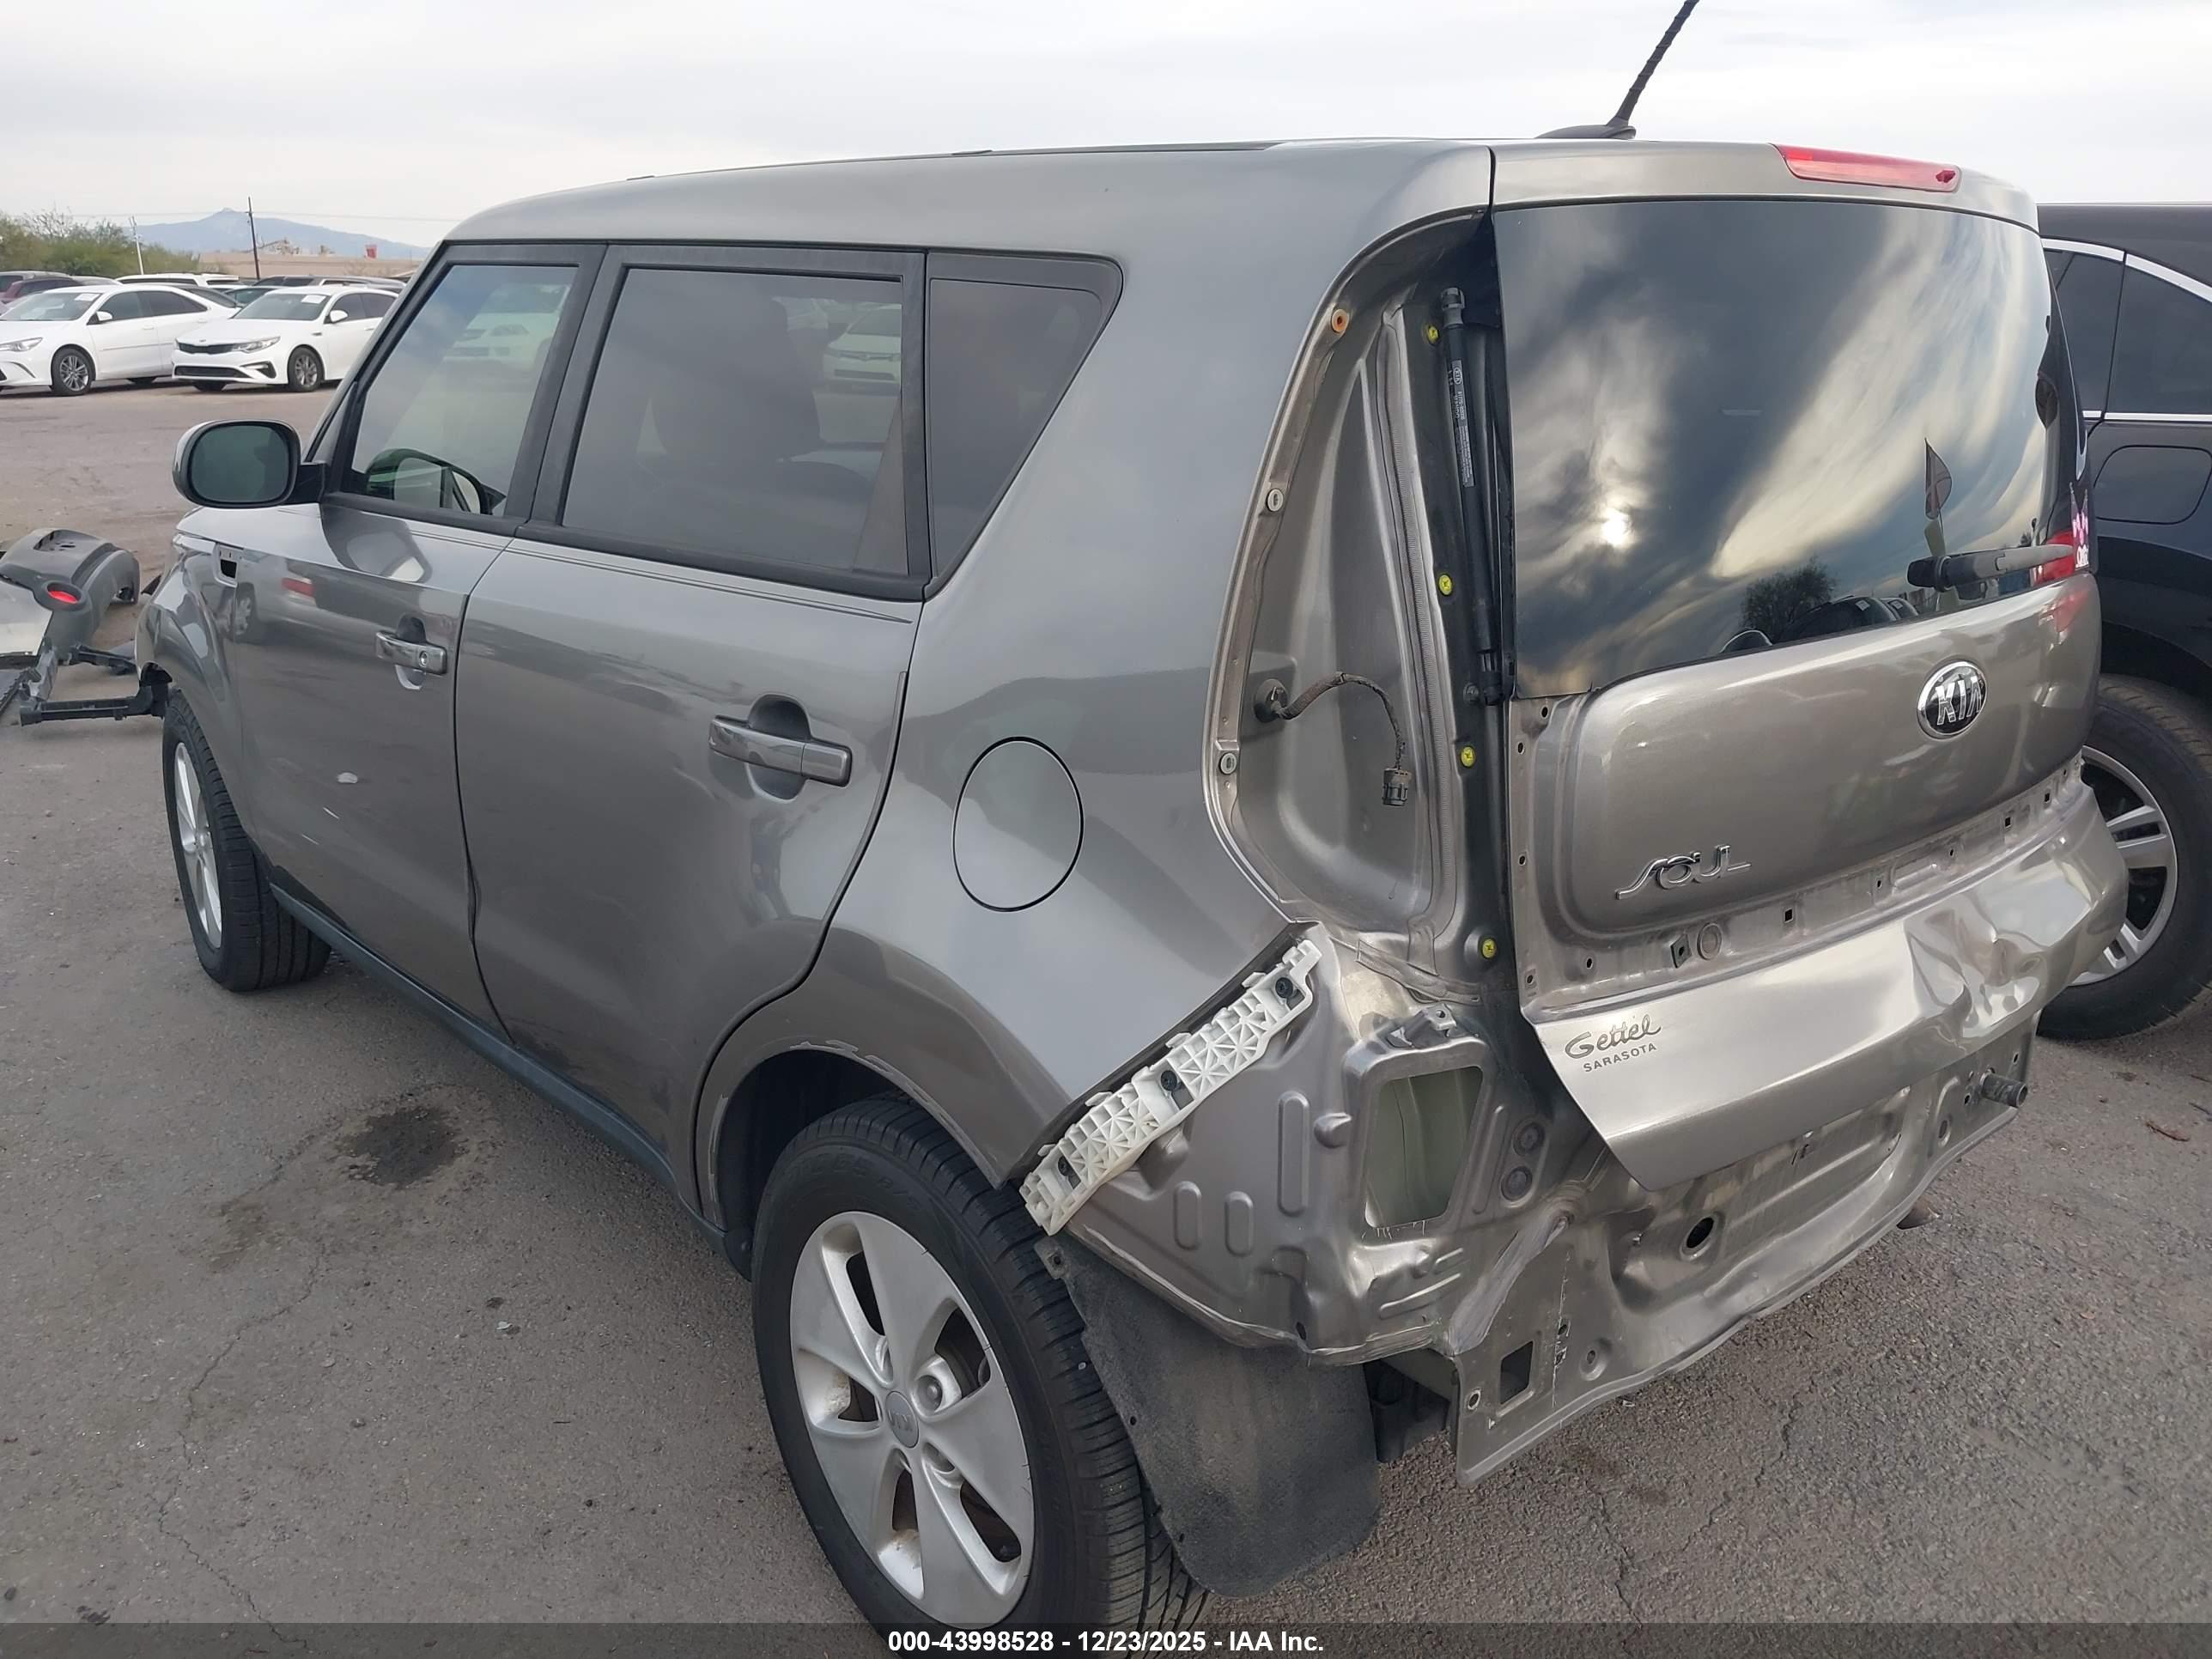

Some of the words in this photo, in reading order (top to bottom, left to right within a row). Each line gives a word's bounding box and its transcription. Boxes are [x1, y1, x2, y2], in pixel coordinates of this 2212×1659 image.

[1936, 675, 1982, 726] KIA
[1614, 845, 1752, 900] SOUL
[1565, 1013, 1662, 1060] Gettel
[1583, 1042, 1657, 1073] SARASOTA
